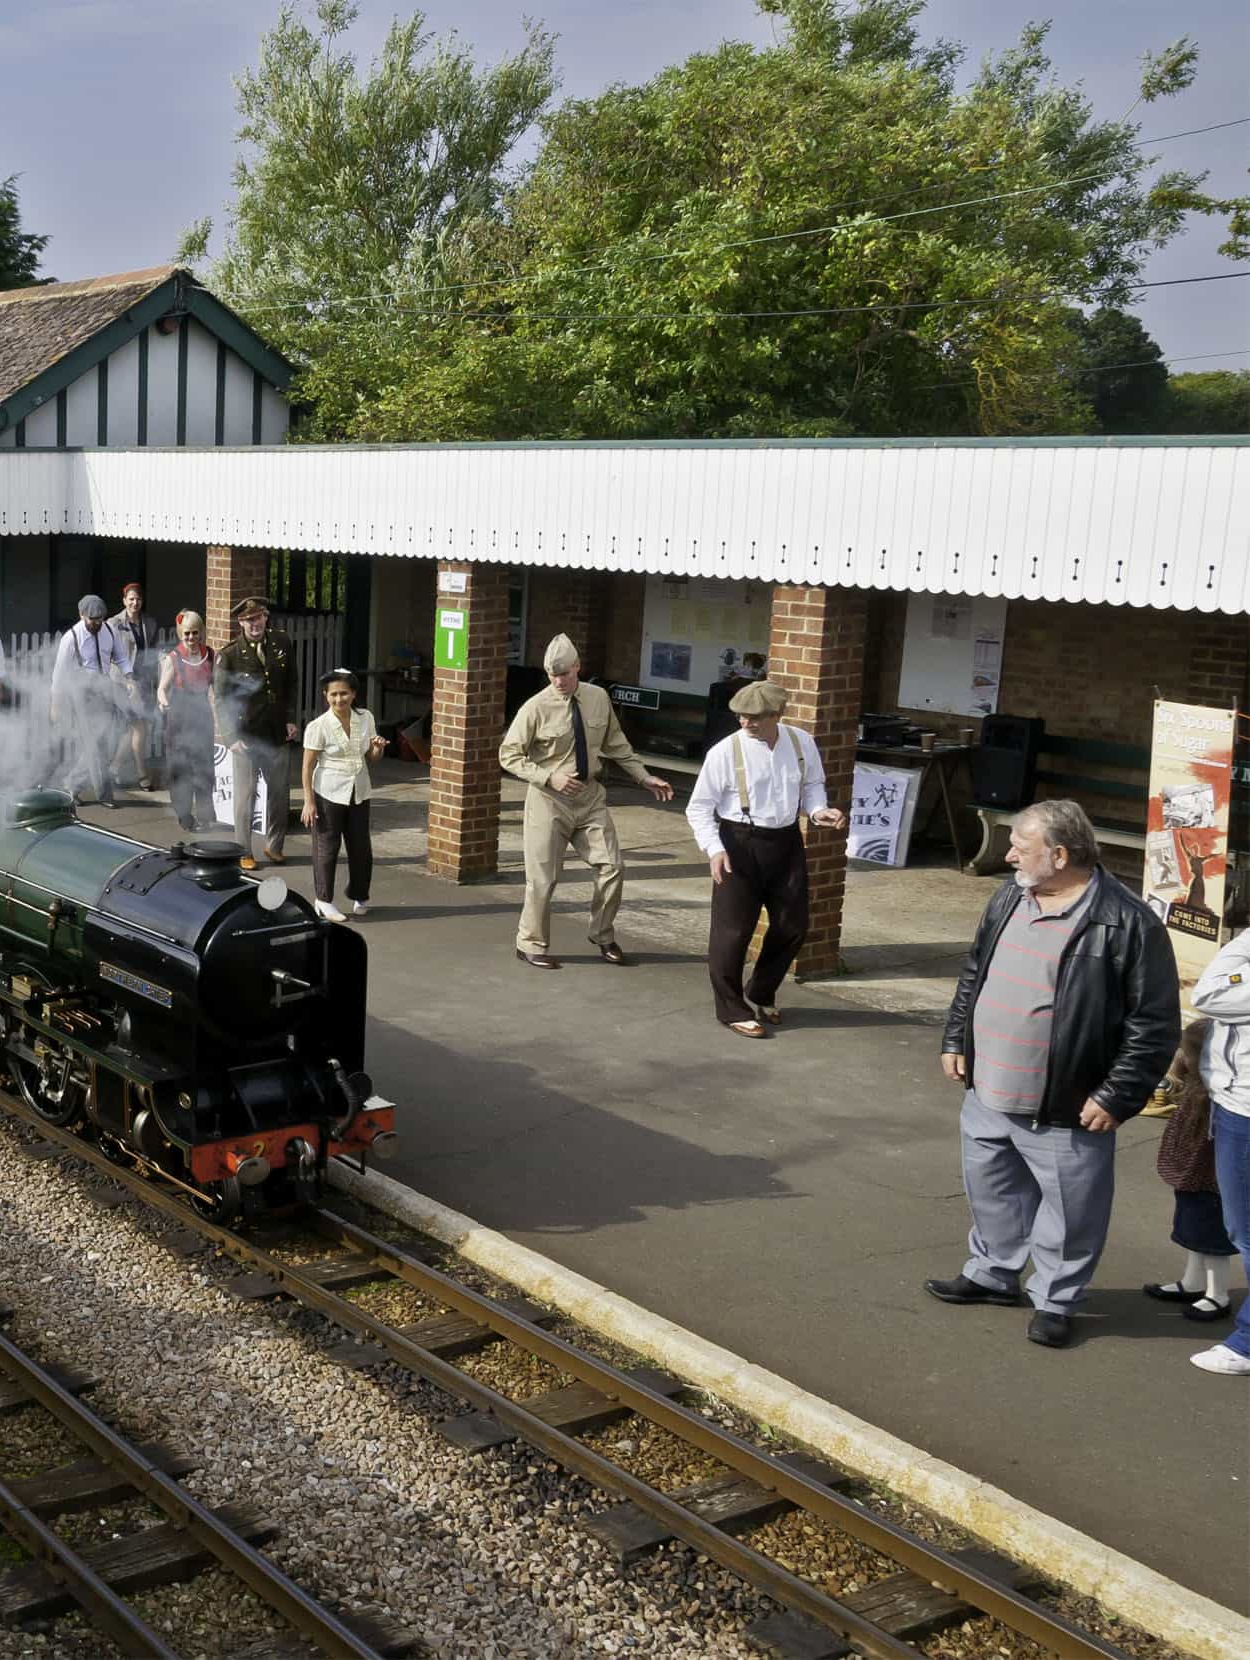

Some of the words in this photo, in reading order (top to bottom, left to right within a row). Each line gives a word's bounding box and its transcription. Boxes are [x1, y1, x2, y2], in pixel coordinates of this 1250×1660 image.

[1181, 710, 1231, 733] Spoons
[1174, 733, 1209, 757] Sugar
[1168, 914, 1180, 924] THE
[1181, 919, 1217, 935] FACTORIES
[1174, 909, 1192, 921] COME
[1194, 915, 1210, 926] INTO
